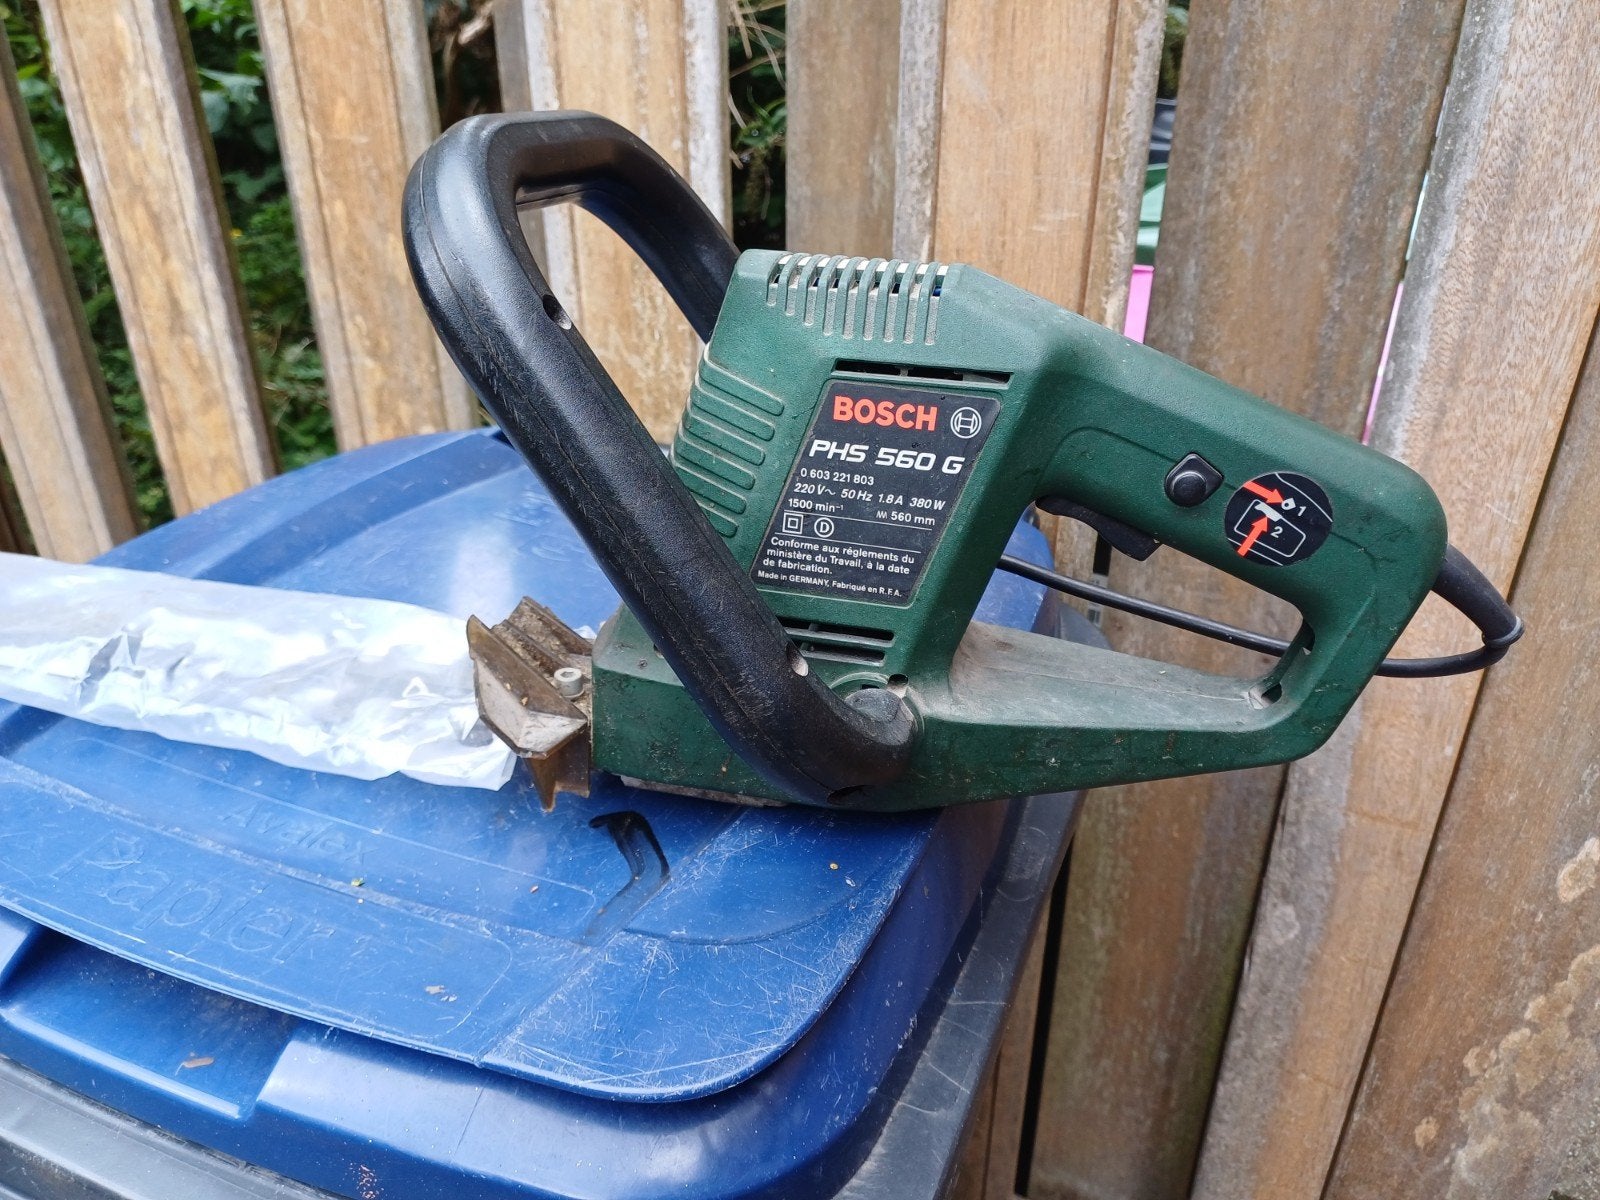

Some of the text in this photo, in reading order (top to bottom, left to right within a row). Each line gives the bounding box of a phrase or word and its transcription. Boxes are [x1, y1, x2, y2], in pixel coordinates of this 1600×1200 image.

[833, 395, 938, 431] BOSCH
[808, 439, 966, 475] PHS 560 G
[801, 469, 874, 485] 0 603 221 803
[788, 498, 813, 509] 1500
[891, 511, 912, 522] 560
[914, 515, 935, 526] mm
[1297, 506, 1306, 516] 1
[1270, 526, 1283, 538] 2
[766, 549, 910, 575] ministère du Travail, à la date
[771, 537, 819, 551] Conforme
[822, 544, 840, 554] aux
[901, 552, 915, 564] du
[763, 558, 833, 575] de fabrication.
[758, 570, 779, 580] Made
[832, 581, 867, 593] Fabriqué
[868, 585, 877, 593] en
